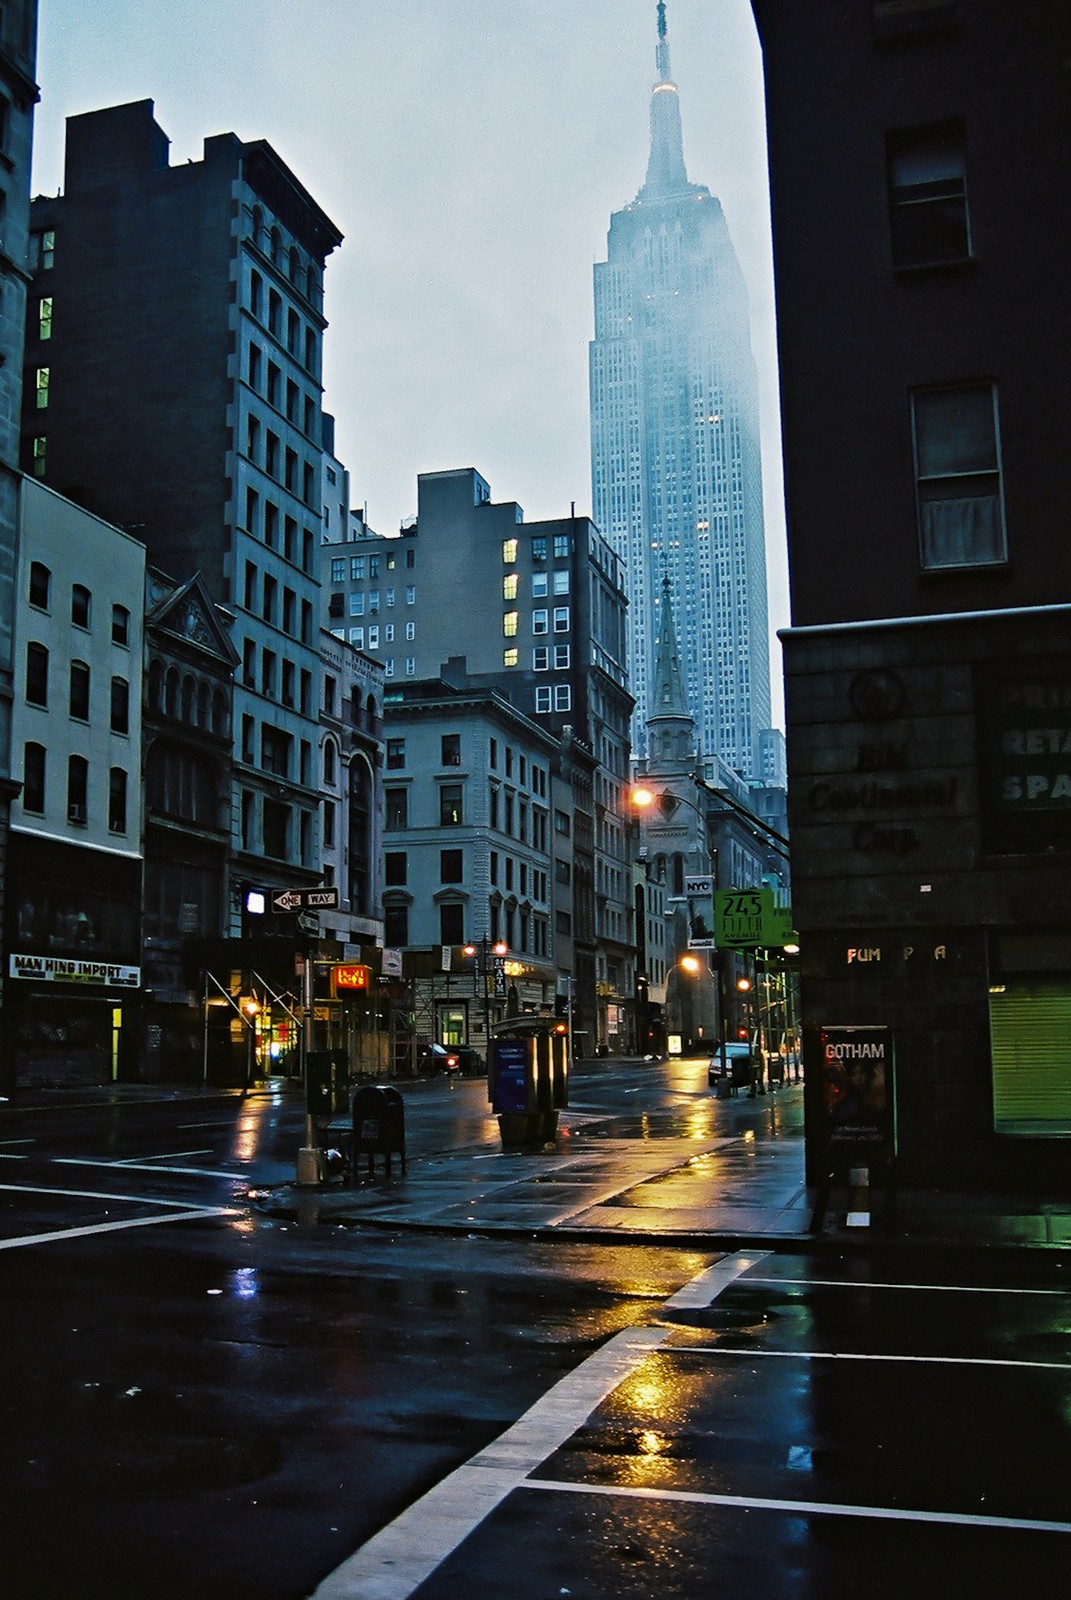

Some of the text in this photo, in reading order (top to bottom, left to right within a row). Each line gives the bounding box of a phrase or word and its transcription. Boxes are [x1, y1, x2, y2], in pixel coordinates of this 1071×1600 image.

[687, 881, 711, 892] NYC
[281, 894, 331, 906] ONE WAY
[723, 896, 762, 917] 245
[723, 917, 762, 932] FIFTH
[723, 931, 761, 939] AVENUE
[15, 955, 43, 970] MAN
[45, 959, 75, 974] HING
[78, 962, 122, 978] IMPORT
[495, 968, 505, 993] ATM
[825, 1043, 885, 1059] GOTHAM
